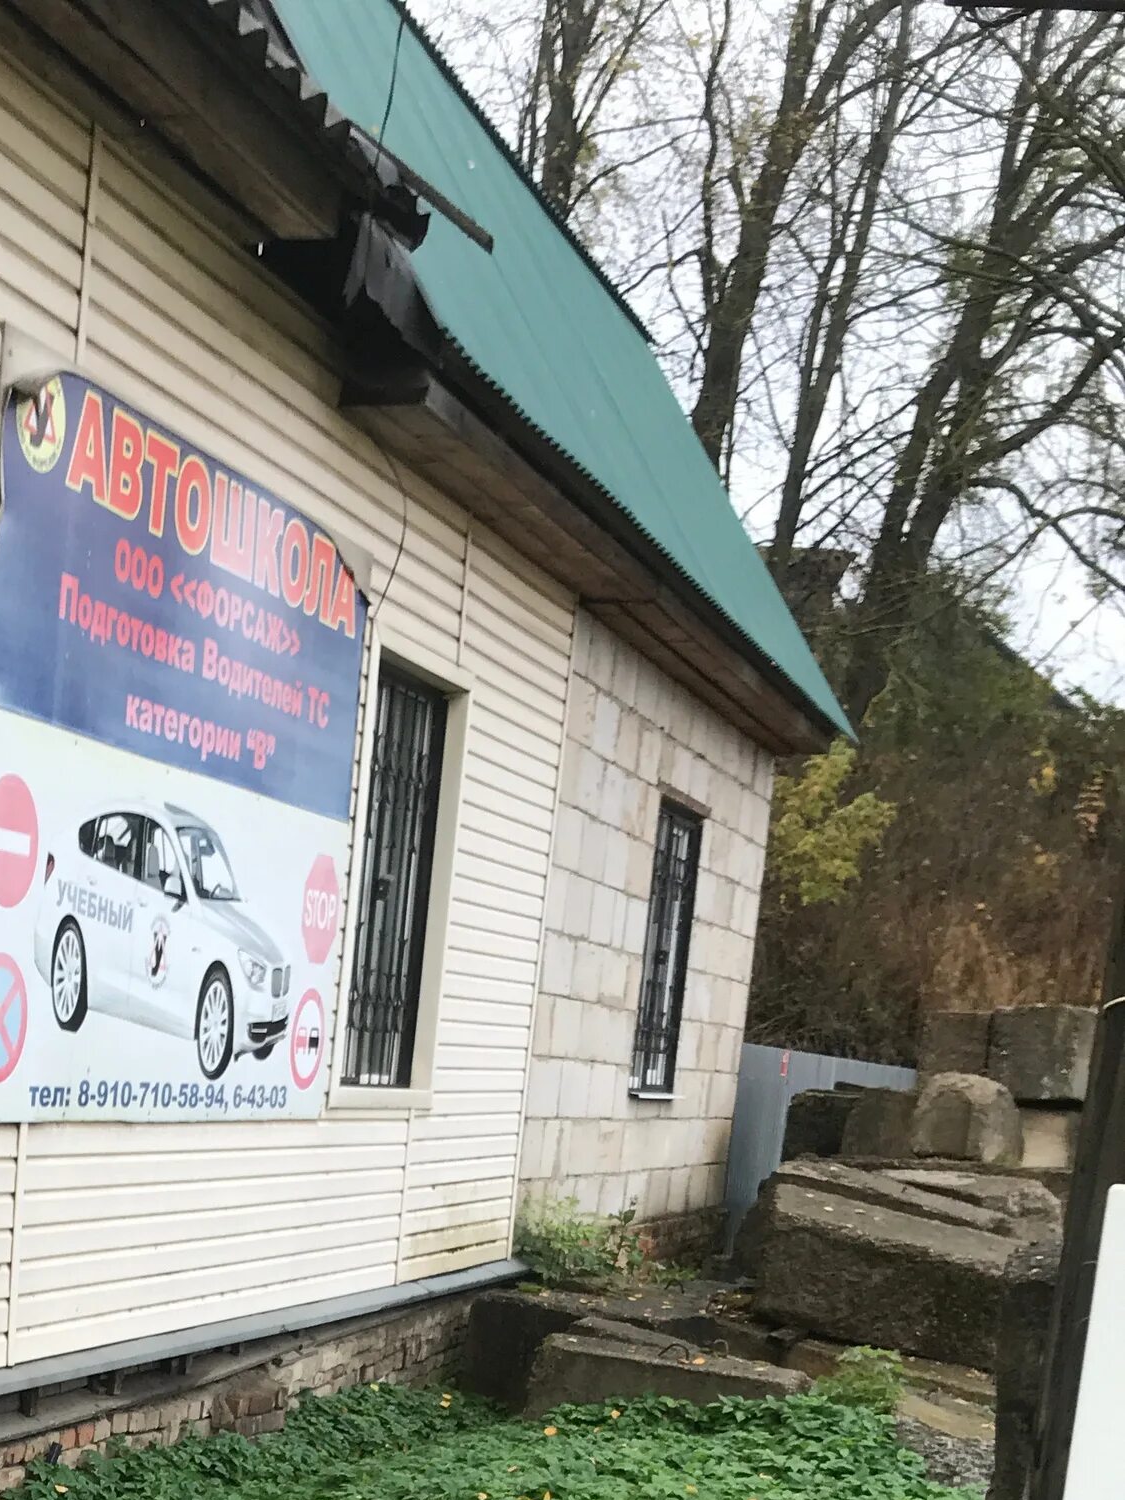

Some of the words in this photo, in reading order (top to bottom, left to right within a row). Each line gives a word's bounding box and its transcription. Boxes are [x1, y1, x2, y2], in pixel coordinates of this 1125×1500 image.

[66, 389, 355, 639] АВТОШКОЛА
[115, 538, 164, 599] ООО
[58, 572, 194, 672] Подготовка
[202, 638, 303, 714] Водителей
[306, 686, 330, 729] ТС
[125, 694, 241, 762] категории
[56, 878, 134, 933] УЧЕБНЫЙ
[304, 888, 336, 931] STOP
[29, 1084, 71, 1108] тел:
[78, 1079, 229, 1114] 8-910-710-58-94,
[233, 1084, 287, 1109] 6-43-03
